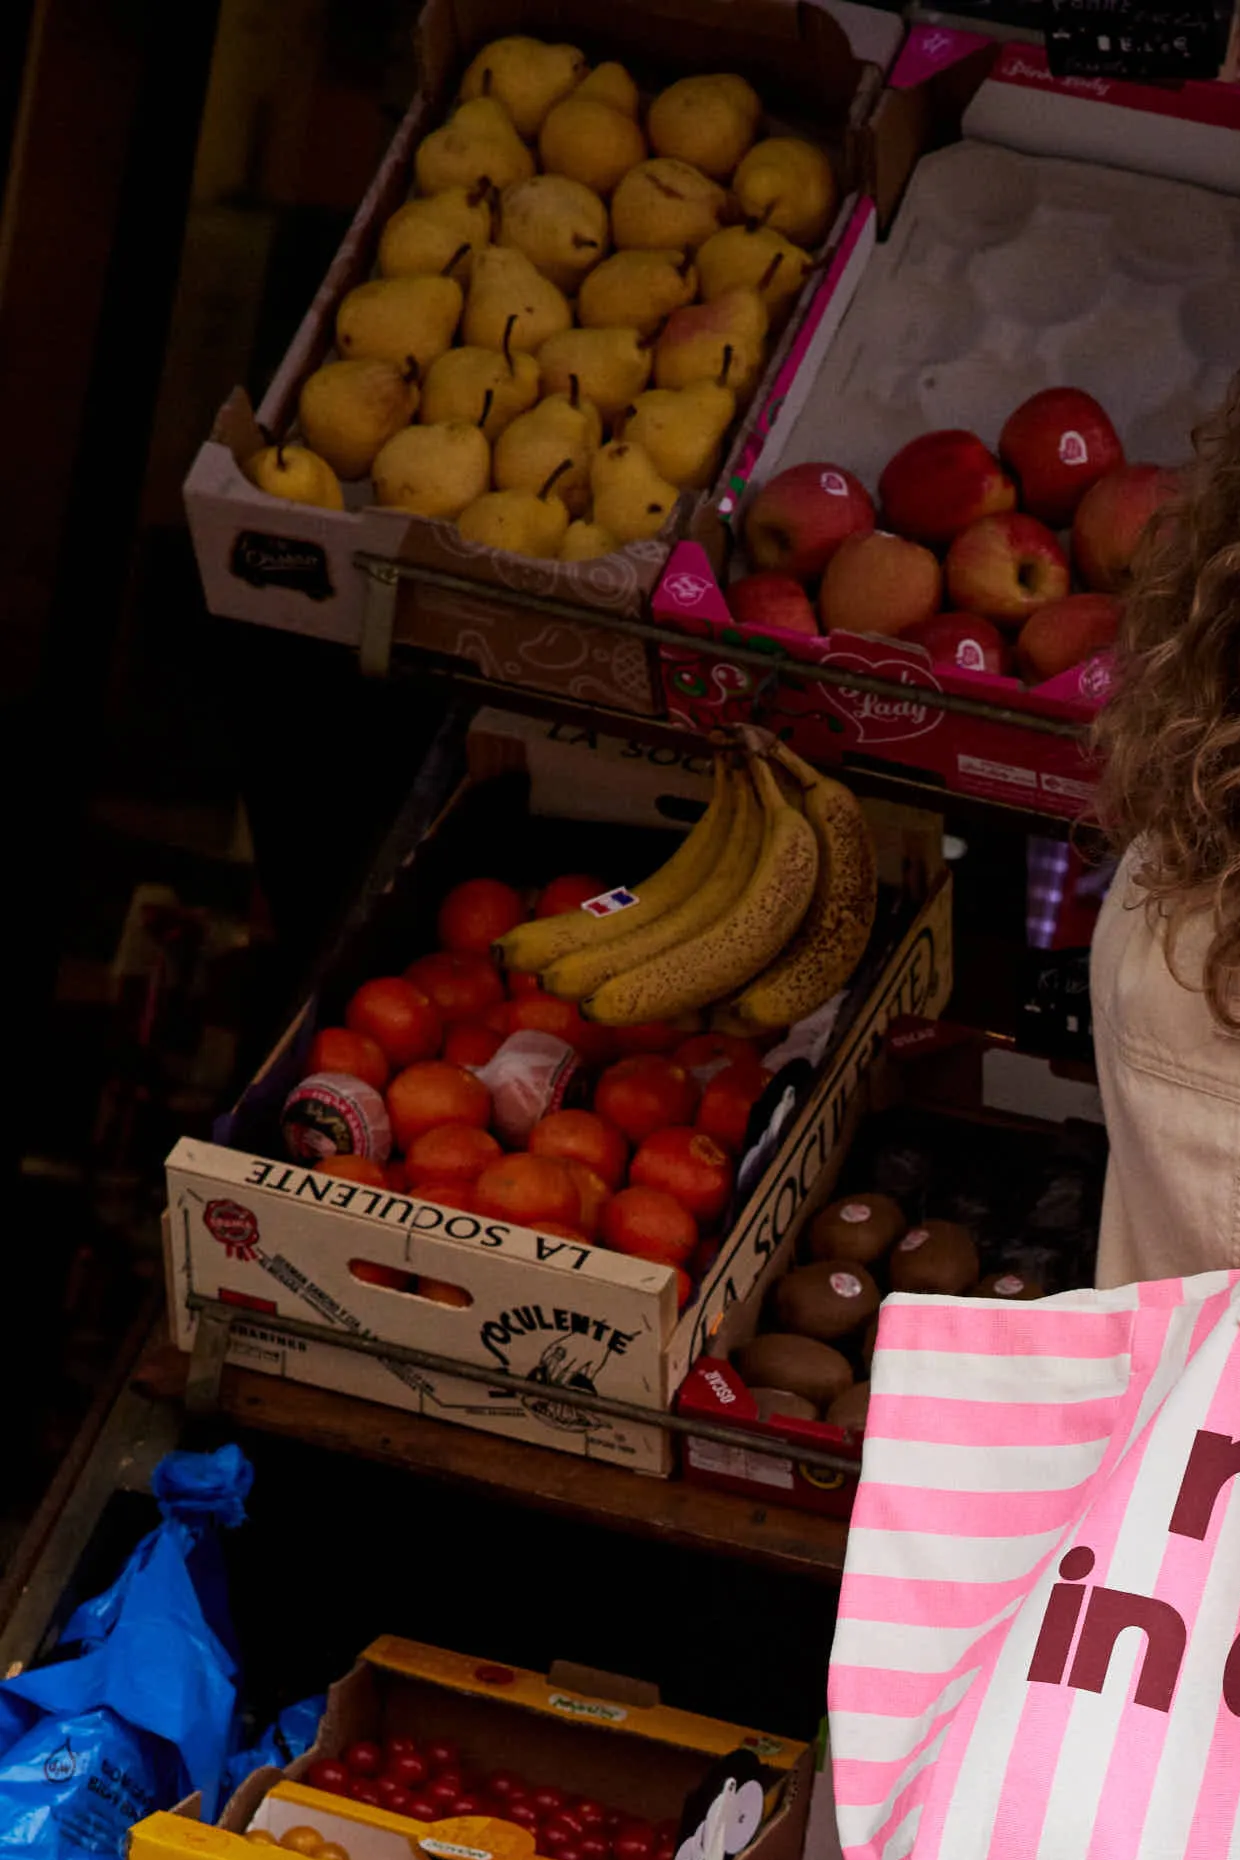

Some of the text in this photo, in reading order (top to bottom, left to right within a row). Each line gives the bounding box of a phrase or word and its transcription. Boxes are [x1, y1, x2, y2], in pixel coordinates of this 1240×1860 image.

[243, 1160, 592, 1270] LA SOCULENTE
[480, 1305, 642, 1367] SOCULENTE
[1026, 1545, 1188, 1713] in
